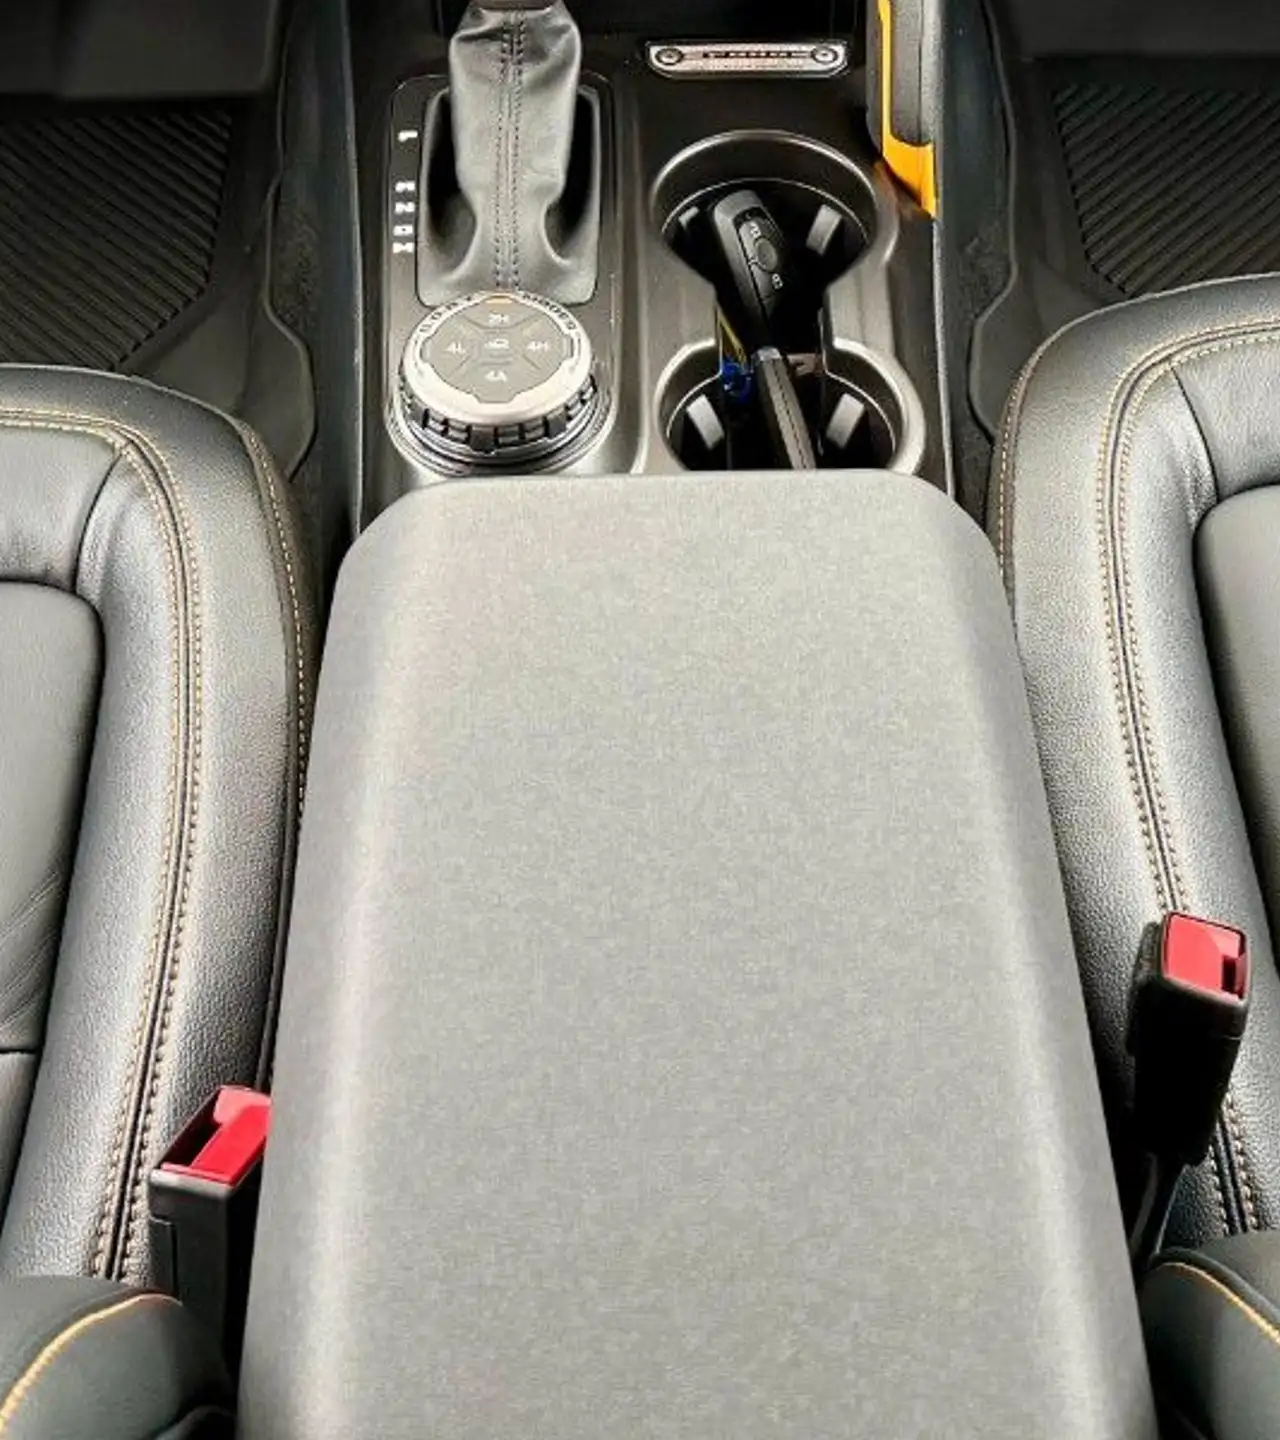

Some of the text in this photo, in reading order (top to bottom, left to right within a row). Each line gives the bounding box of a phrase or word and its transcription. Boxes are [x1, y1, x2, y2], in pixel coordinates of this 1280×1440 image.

[488, 313, 510, 324] 2H
[527, 340, 549, 352] 4H
[485, 371, 507, 382] 4A
